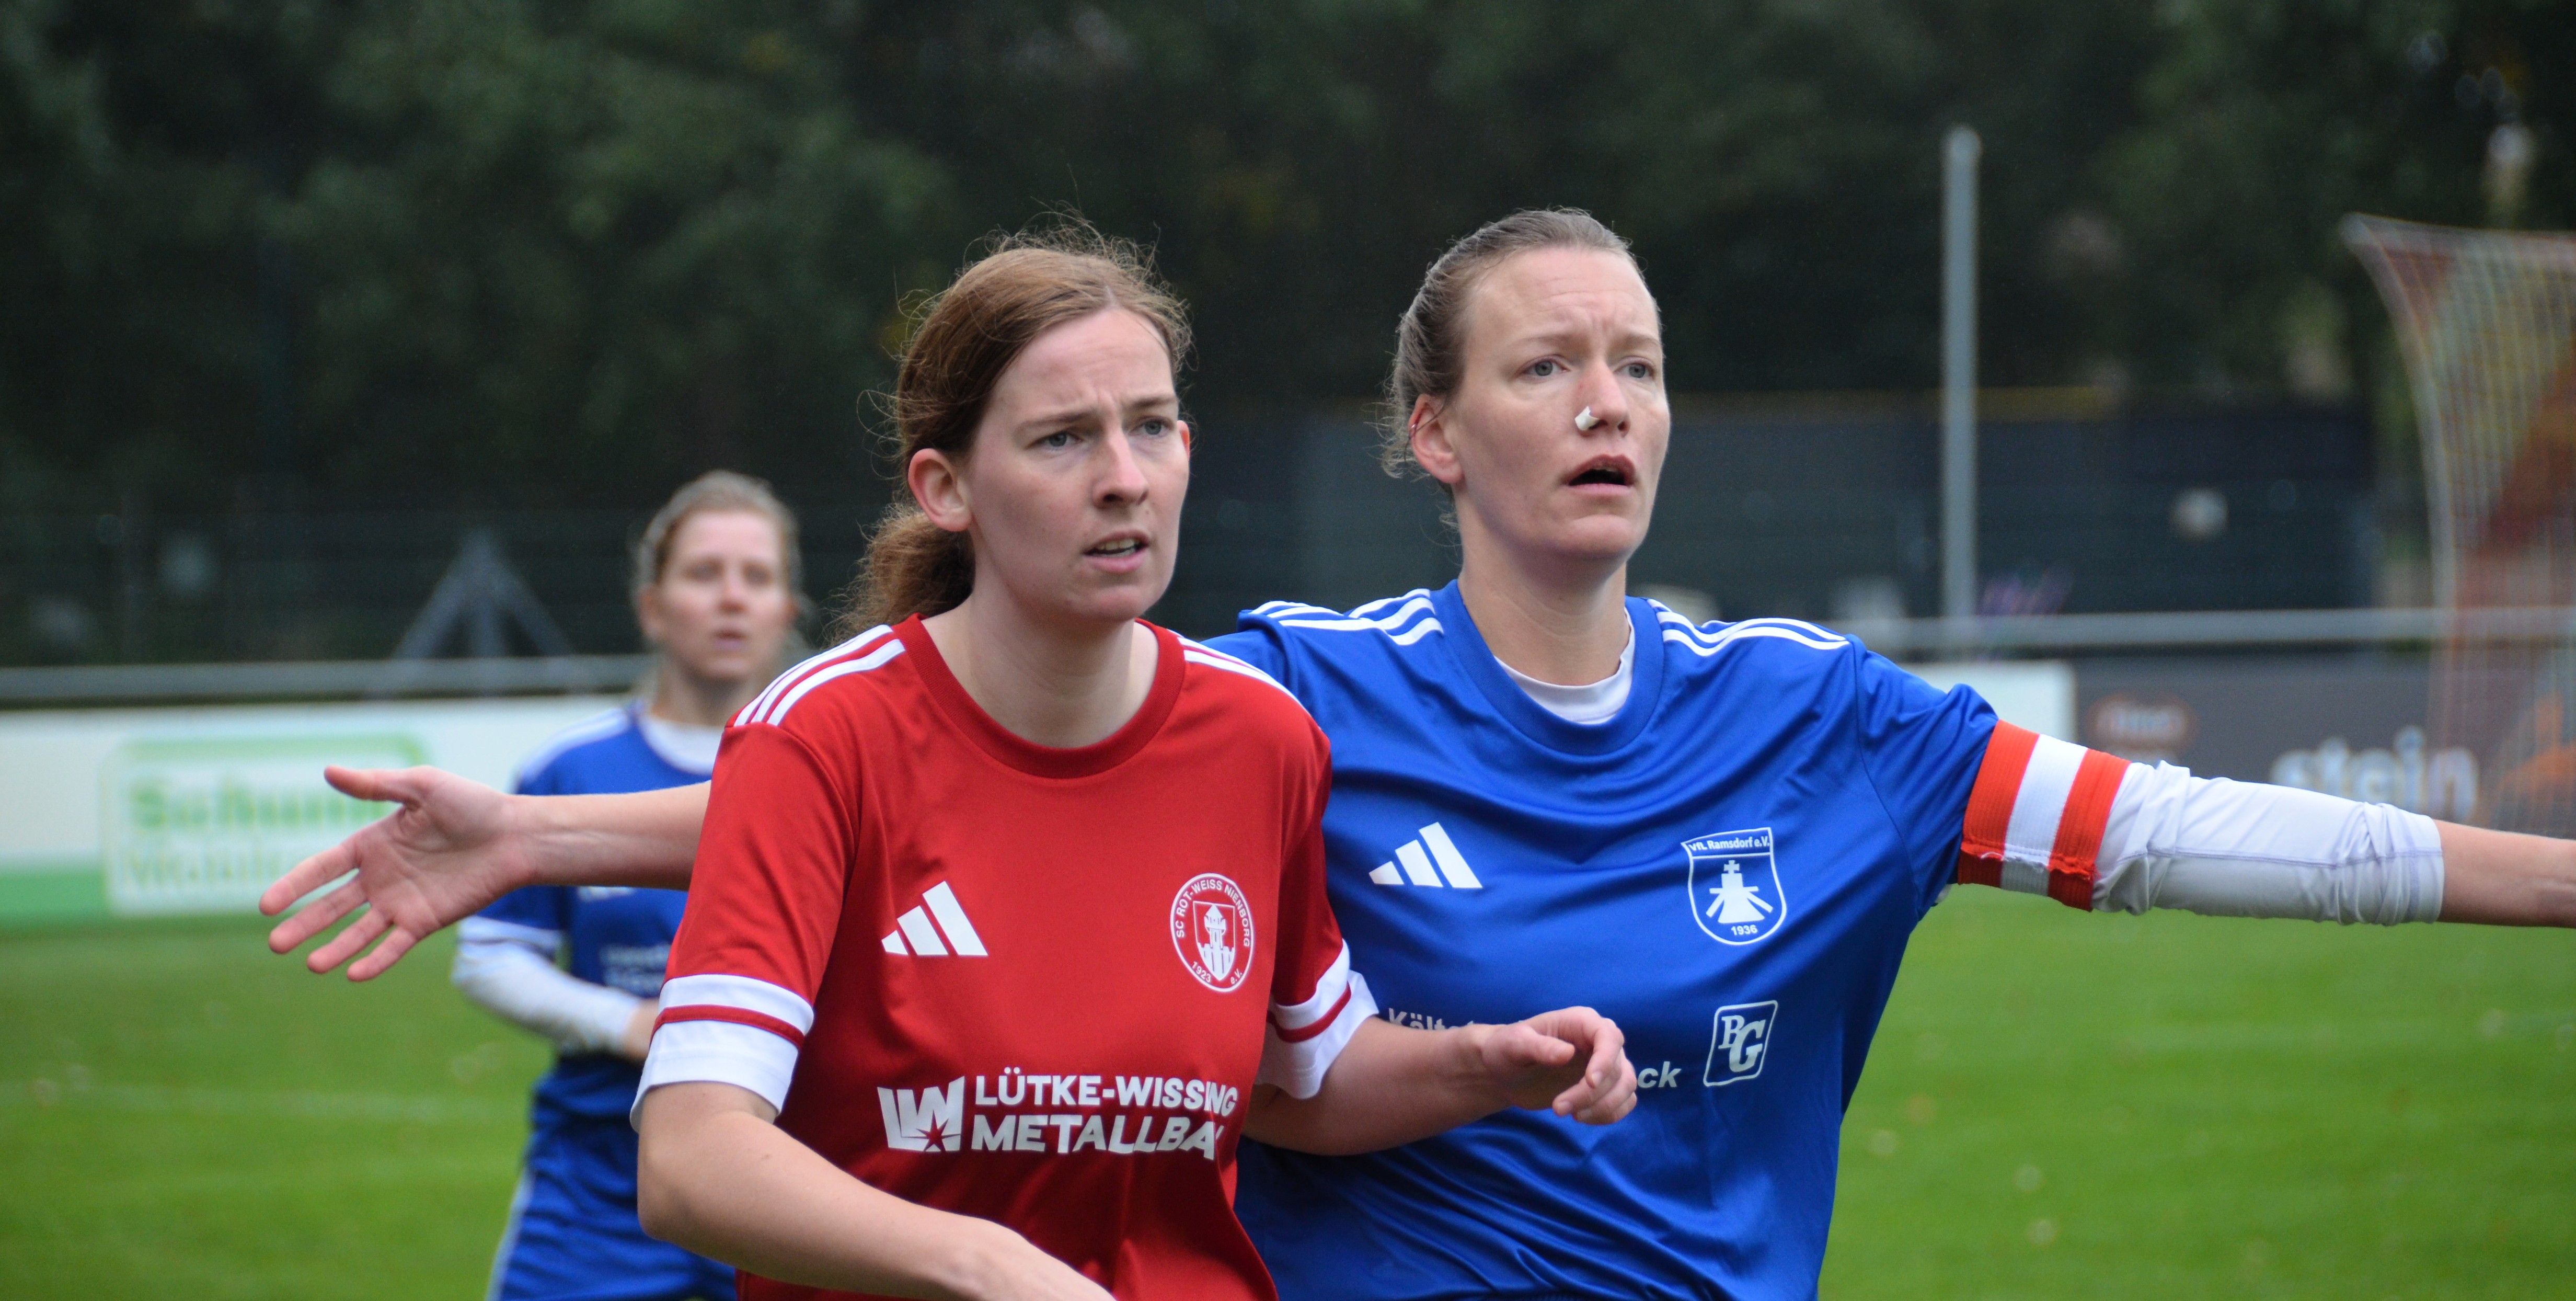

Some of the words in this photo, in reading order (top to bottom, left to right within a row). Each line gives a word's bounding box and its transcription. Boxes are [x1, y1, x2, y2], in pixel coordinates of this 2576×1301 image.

[1707, 836, 1753, 850] Ramsdorf
[1754, 835, 1770, 847] e.V.
[1176, 878, 1223, 917] ROT-WEISS
[1175, 920, 1186, 938] SC
[1224, 885, 1250, 948] NIENBORG
[1730, 924, 1758, 936] 1936
[1191, 961, 1212, 983] 1923
[1230, 968, 1243, 985] e.V.
[1718, 1014, 1766, 1072] BG
[1637, 1060, 1682, 1088] ck
[975, 1067, 1238, 1117] LÜTKE-WISSING
[970, 1114, 1225, 1161] METALLBA
